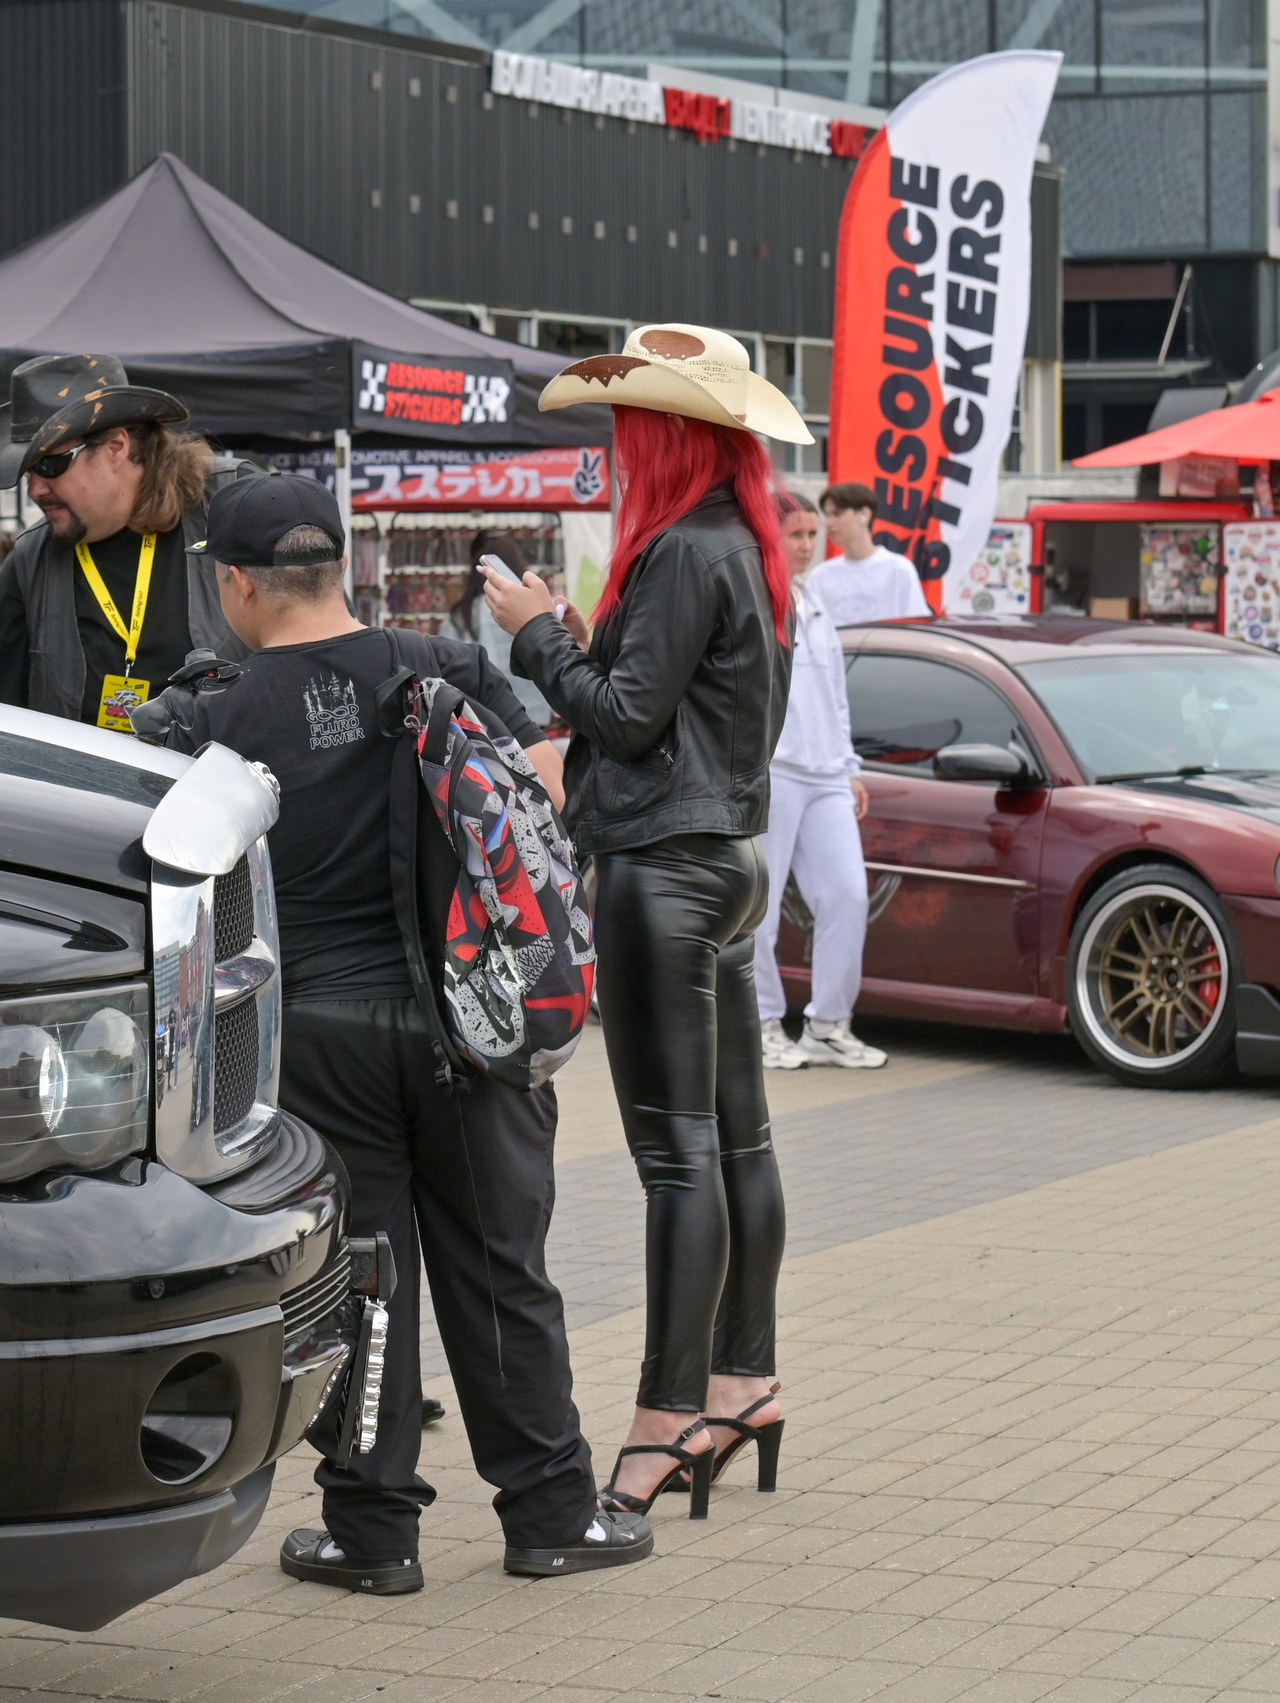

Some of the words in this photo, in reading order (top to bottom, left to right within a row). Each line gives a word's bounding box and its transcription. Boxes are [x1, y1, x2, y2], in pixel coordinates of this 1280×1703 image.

[386, 362, 465, 394] RESOURCE
[384, 391, 462, 426] STICKERS
[306, 703, 360, 724] GOOD
[309, 716, 360, 737] FLURO
[309, 727, 365, 751] POWER
[552, 1557, 565, 1567] AIR
[360, 1579, 373, 1588] AIR
